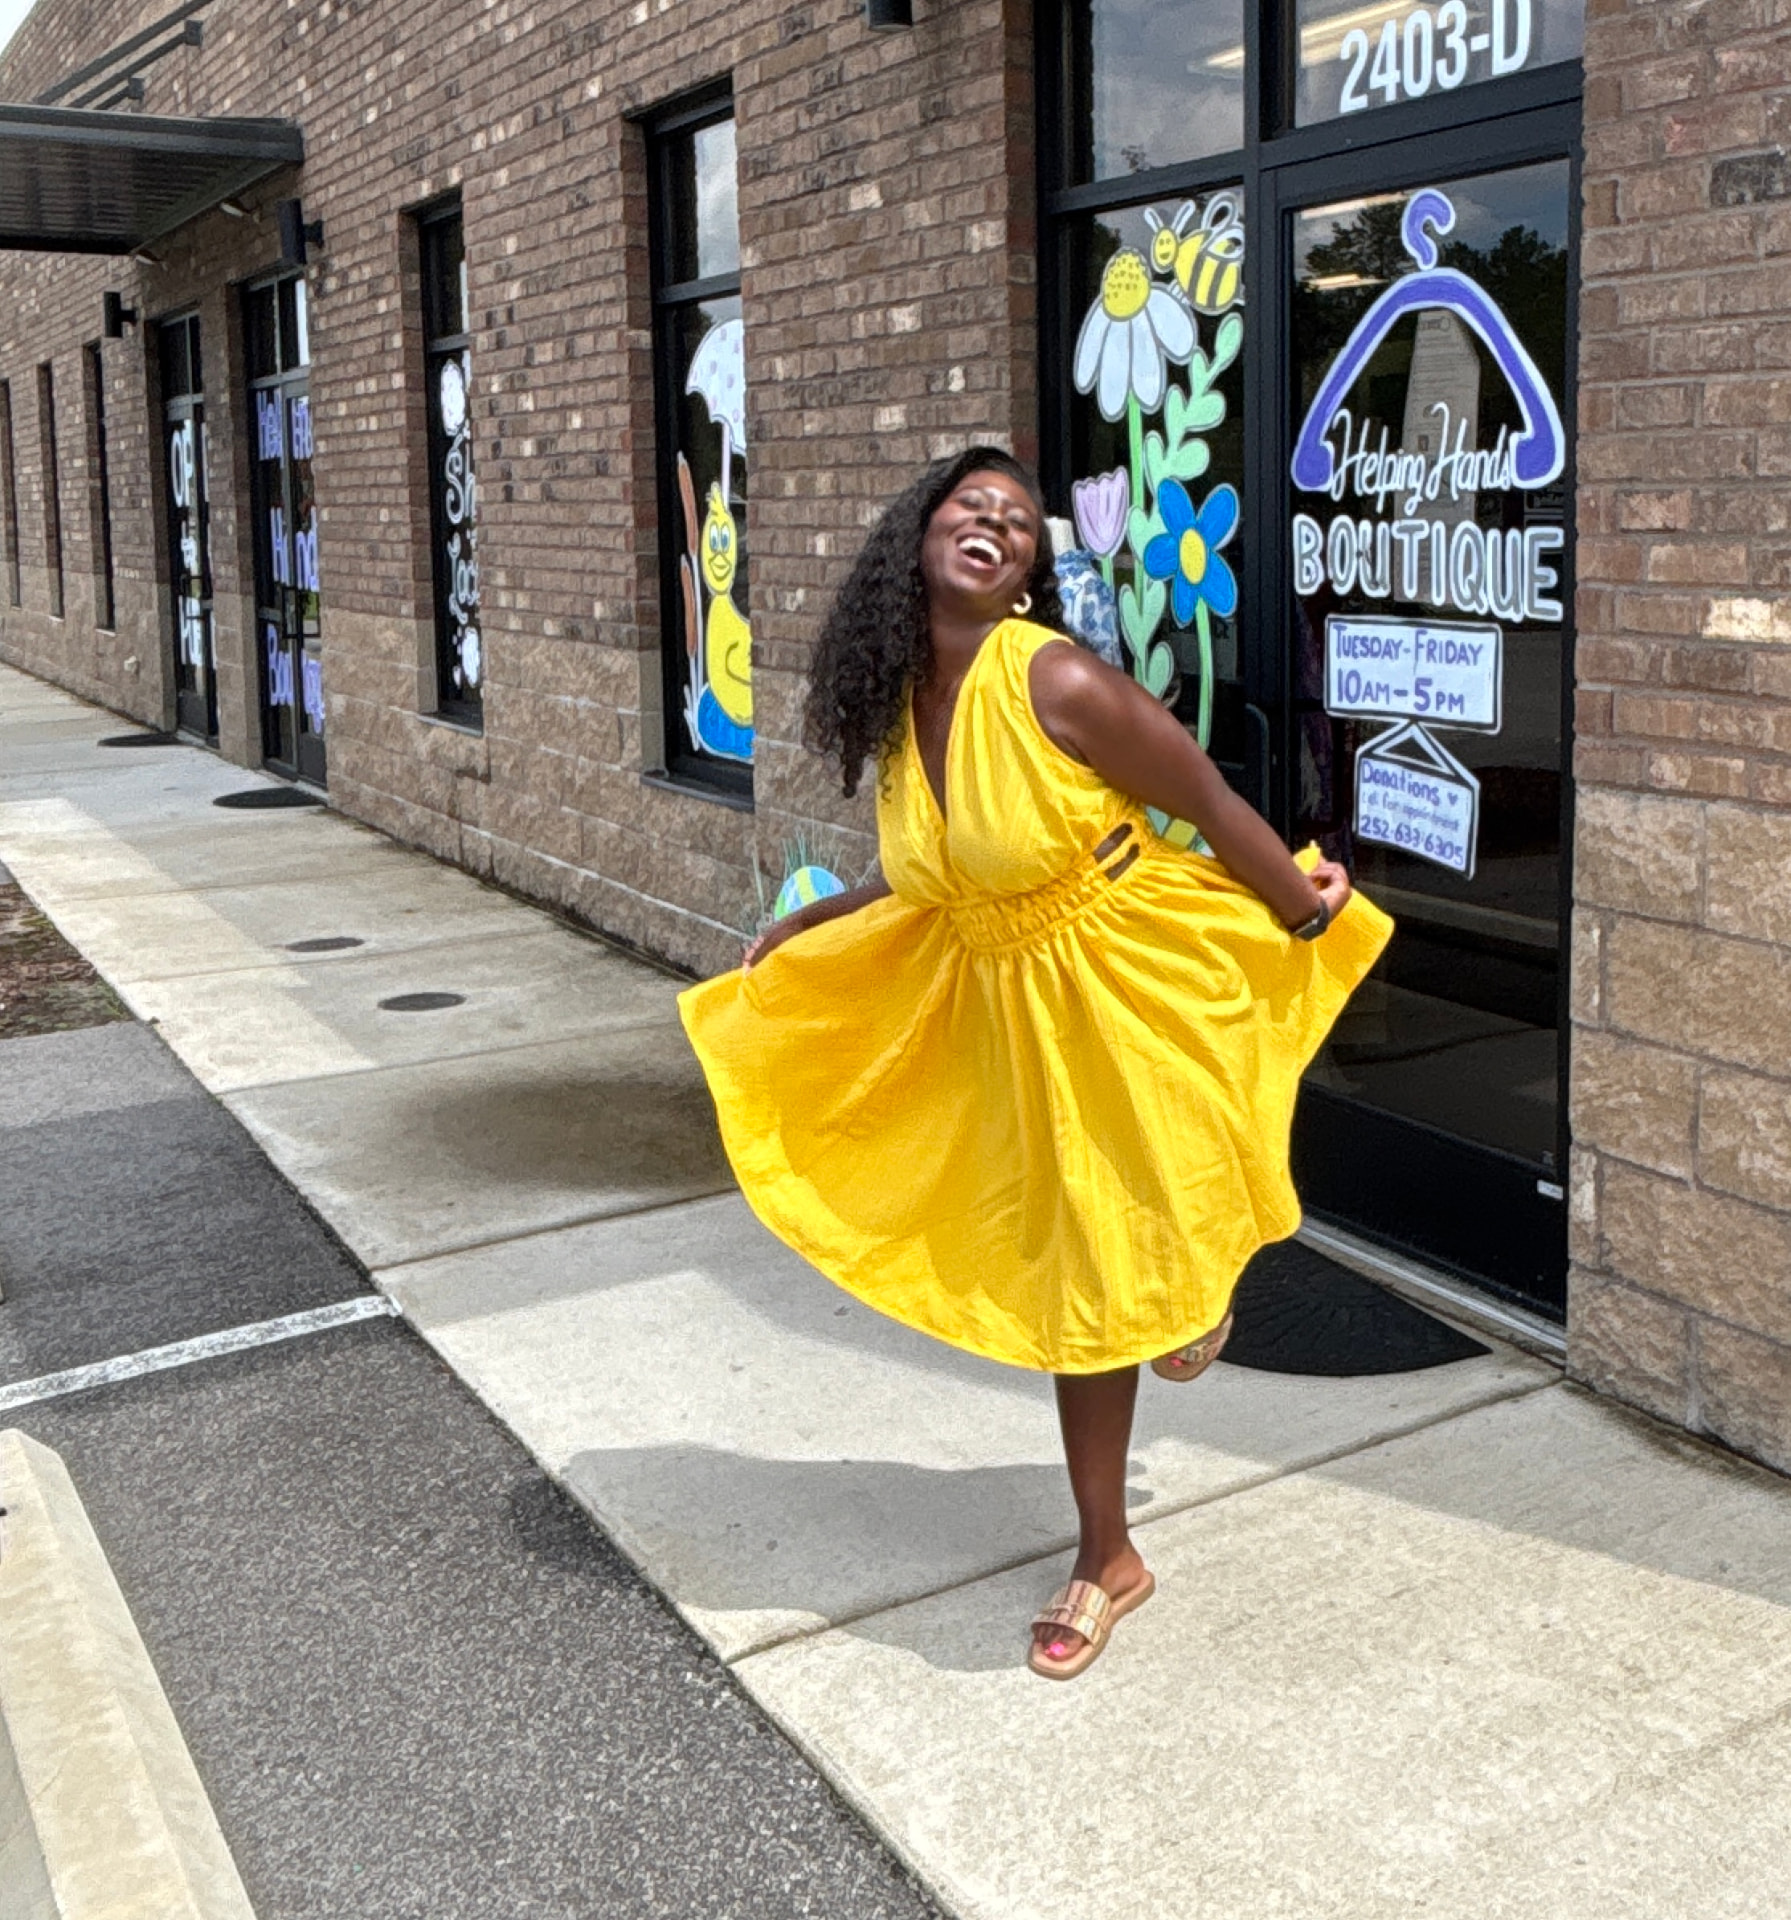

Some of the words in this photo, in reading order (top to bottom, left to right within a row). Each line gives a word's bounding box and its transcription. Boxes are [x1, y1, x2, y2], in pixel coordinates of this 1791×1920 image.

[1339, 0, 1531, 113] 2403-D
[1330, 408, 1426, 516] Helping
[1425, 402, 1511, 500] Hands
[1293, 513, 1564, 622] BOUTIQUE
